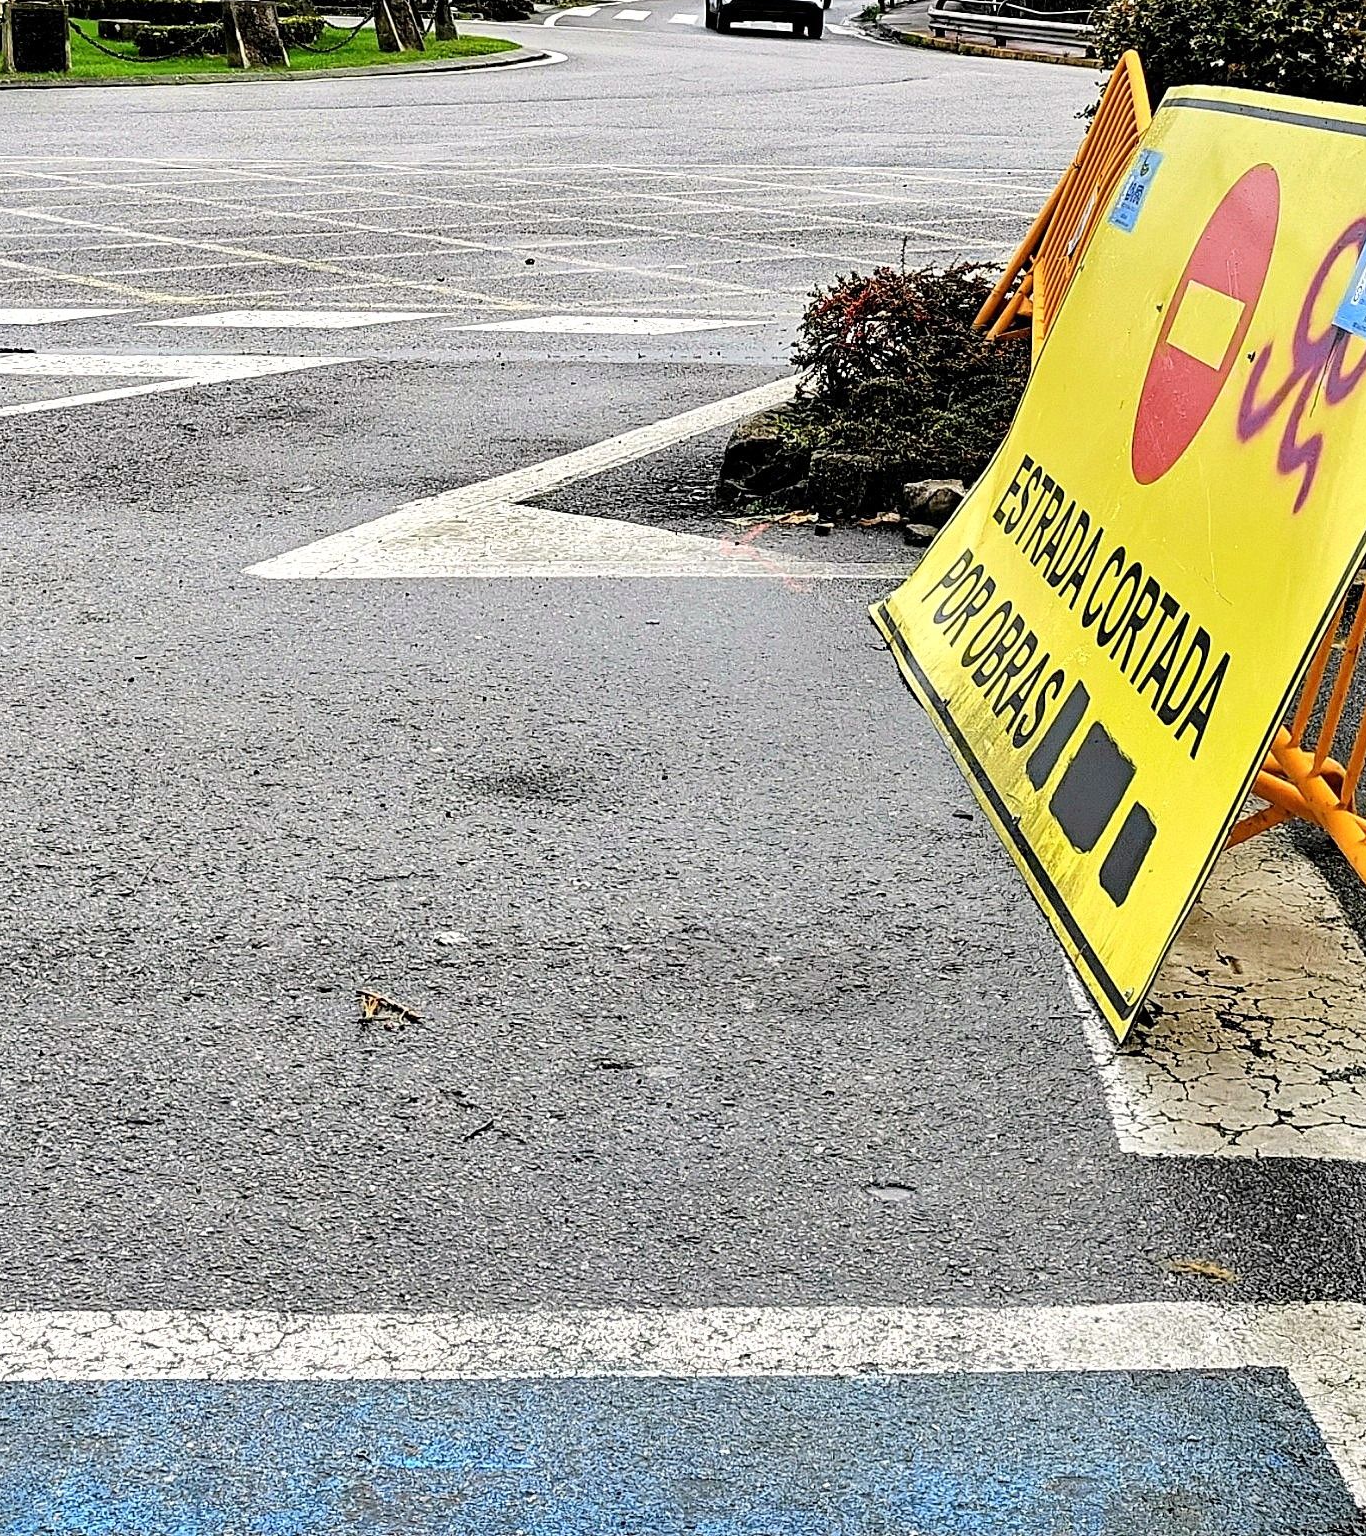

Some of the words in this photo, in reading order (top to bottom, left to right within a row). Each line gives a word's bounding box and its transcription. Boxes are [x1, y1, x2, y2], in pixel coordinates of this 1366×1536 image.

[921, 548, 997, 648] POR
[961, 600, 1065, 749] OBRAS
[993, 454, 1105, 610] ESTRADA
[1081, 545, 1231, 761] CORTADA
